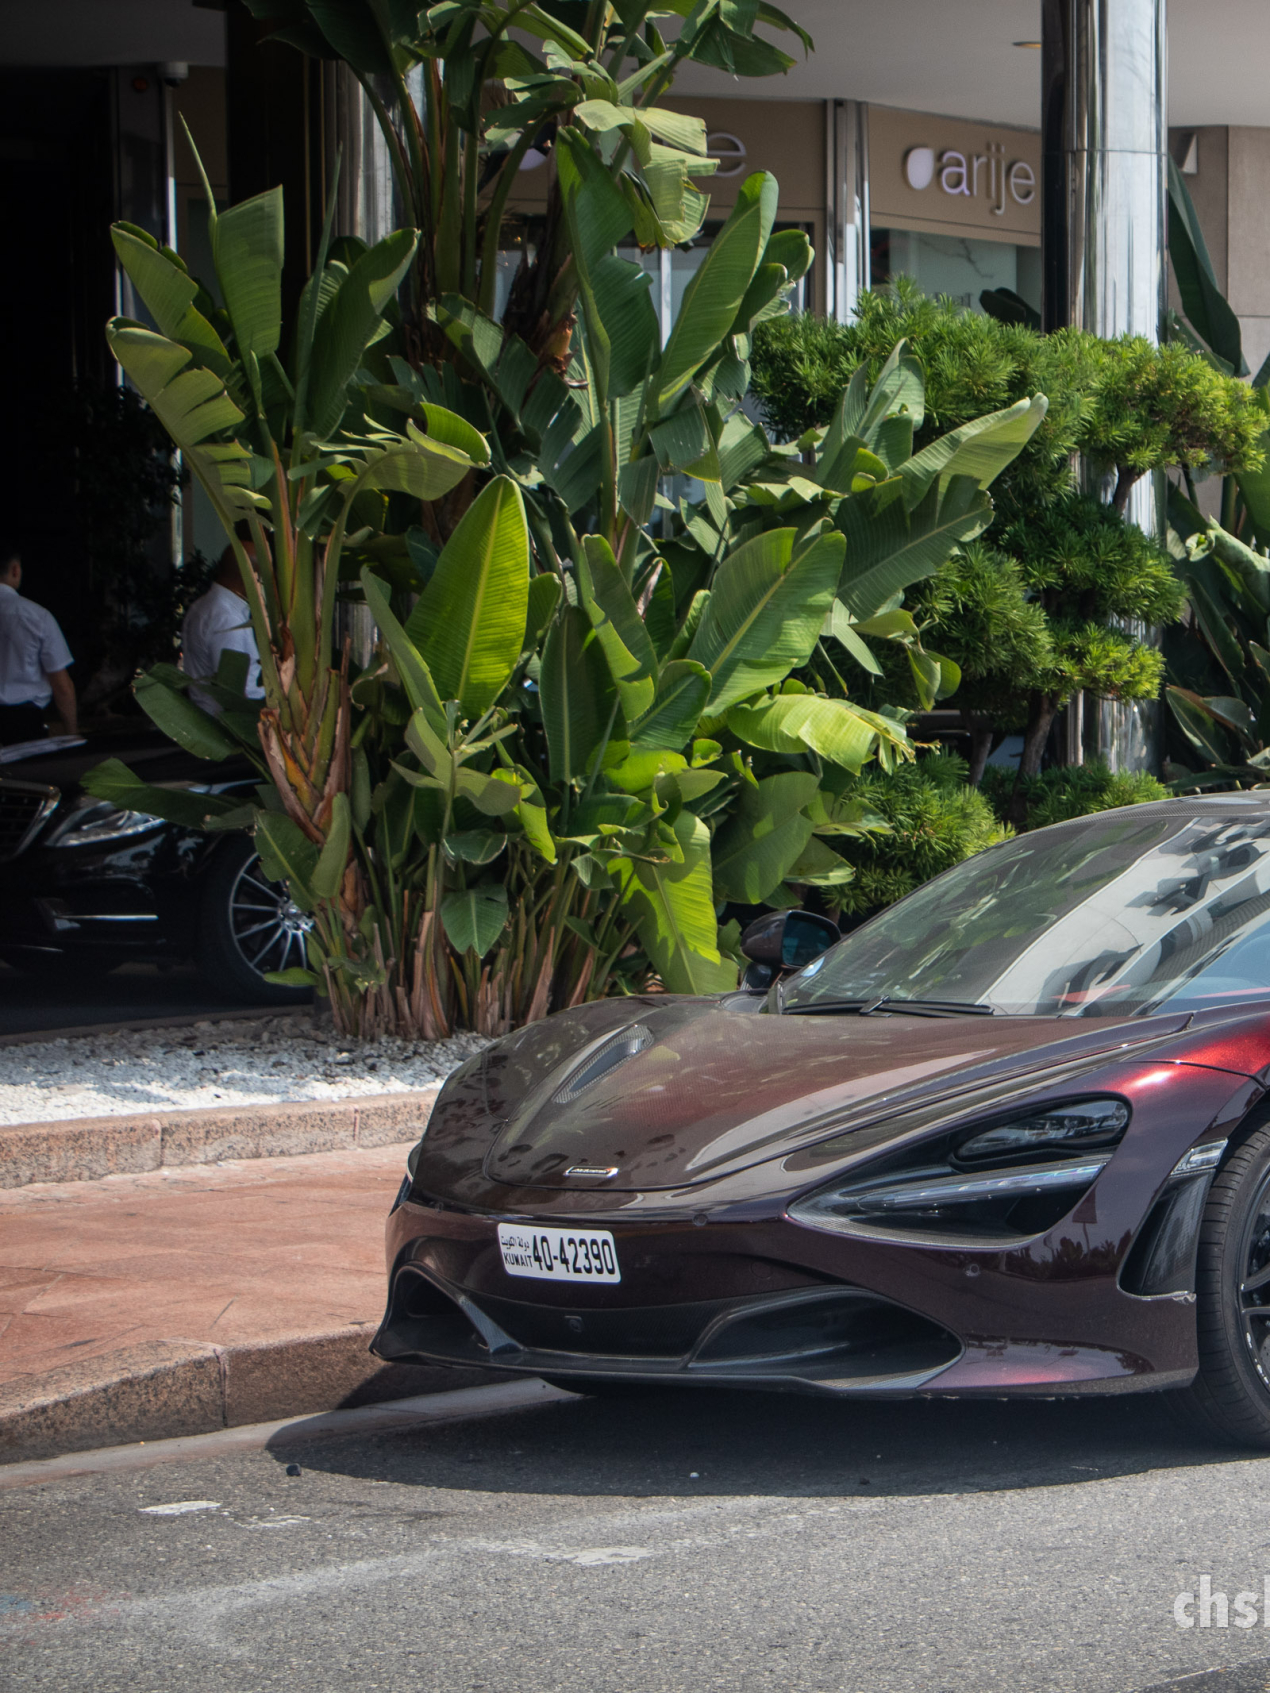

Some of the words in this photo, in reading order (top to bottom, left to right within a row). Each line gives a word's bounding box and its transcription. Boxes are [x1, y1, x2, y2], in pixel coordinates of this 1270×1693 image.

[941, 142, 1036, 216] arije
[503, 1252, 533, 1268] KUWAIT
[533, 1234, 616, 1275] 40-42390
